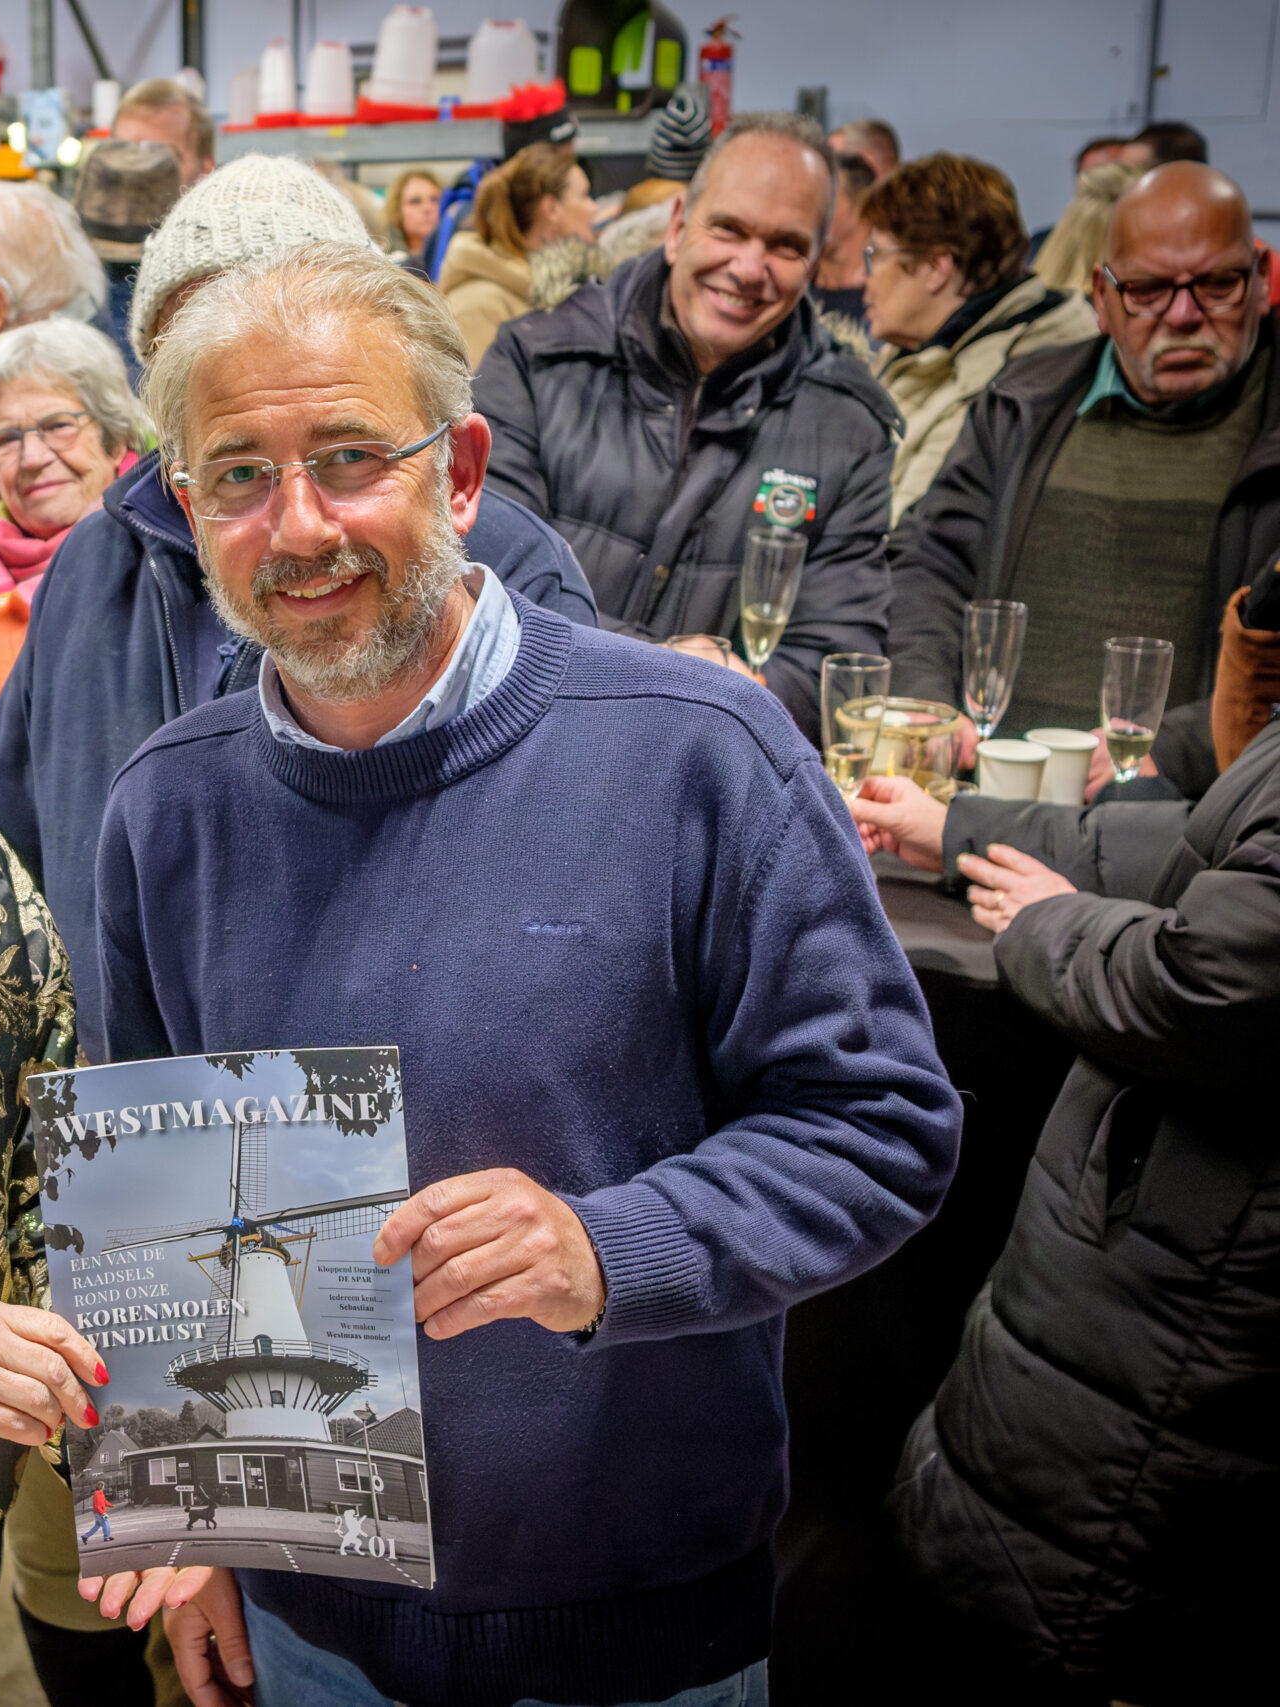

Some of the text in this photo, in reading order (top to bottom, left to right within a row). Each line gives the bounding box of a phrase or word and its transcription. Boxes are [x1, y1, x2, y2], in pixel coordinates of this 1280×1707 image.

[53, 1093, 382, 1143] WESTMAGAZINE
[70, 1247, 165, 1272] EEN VAN DE
[72, 1266, 155, 1290] RAADSELS
[317, 1265, 391, 1275] Kloppend Dorpshart
[338, 1275, 349, 1283] DE
[74, 1283, 170, 1308] ROND ONZE
[76, 1298, 248, 1330] KORENMOLEN
[339, 1303, 375, 1312] Sebastian
[326, 1331, 362, 1340] Westmaas
[340, 1322, 376, 1332] We maken
